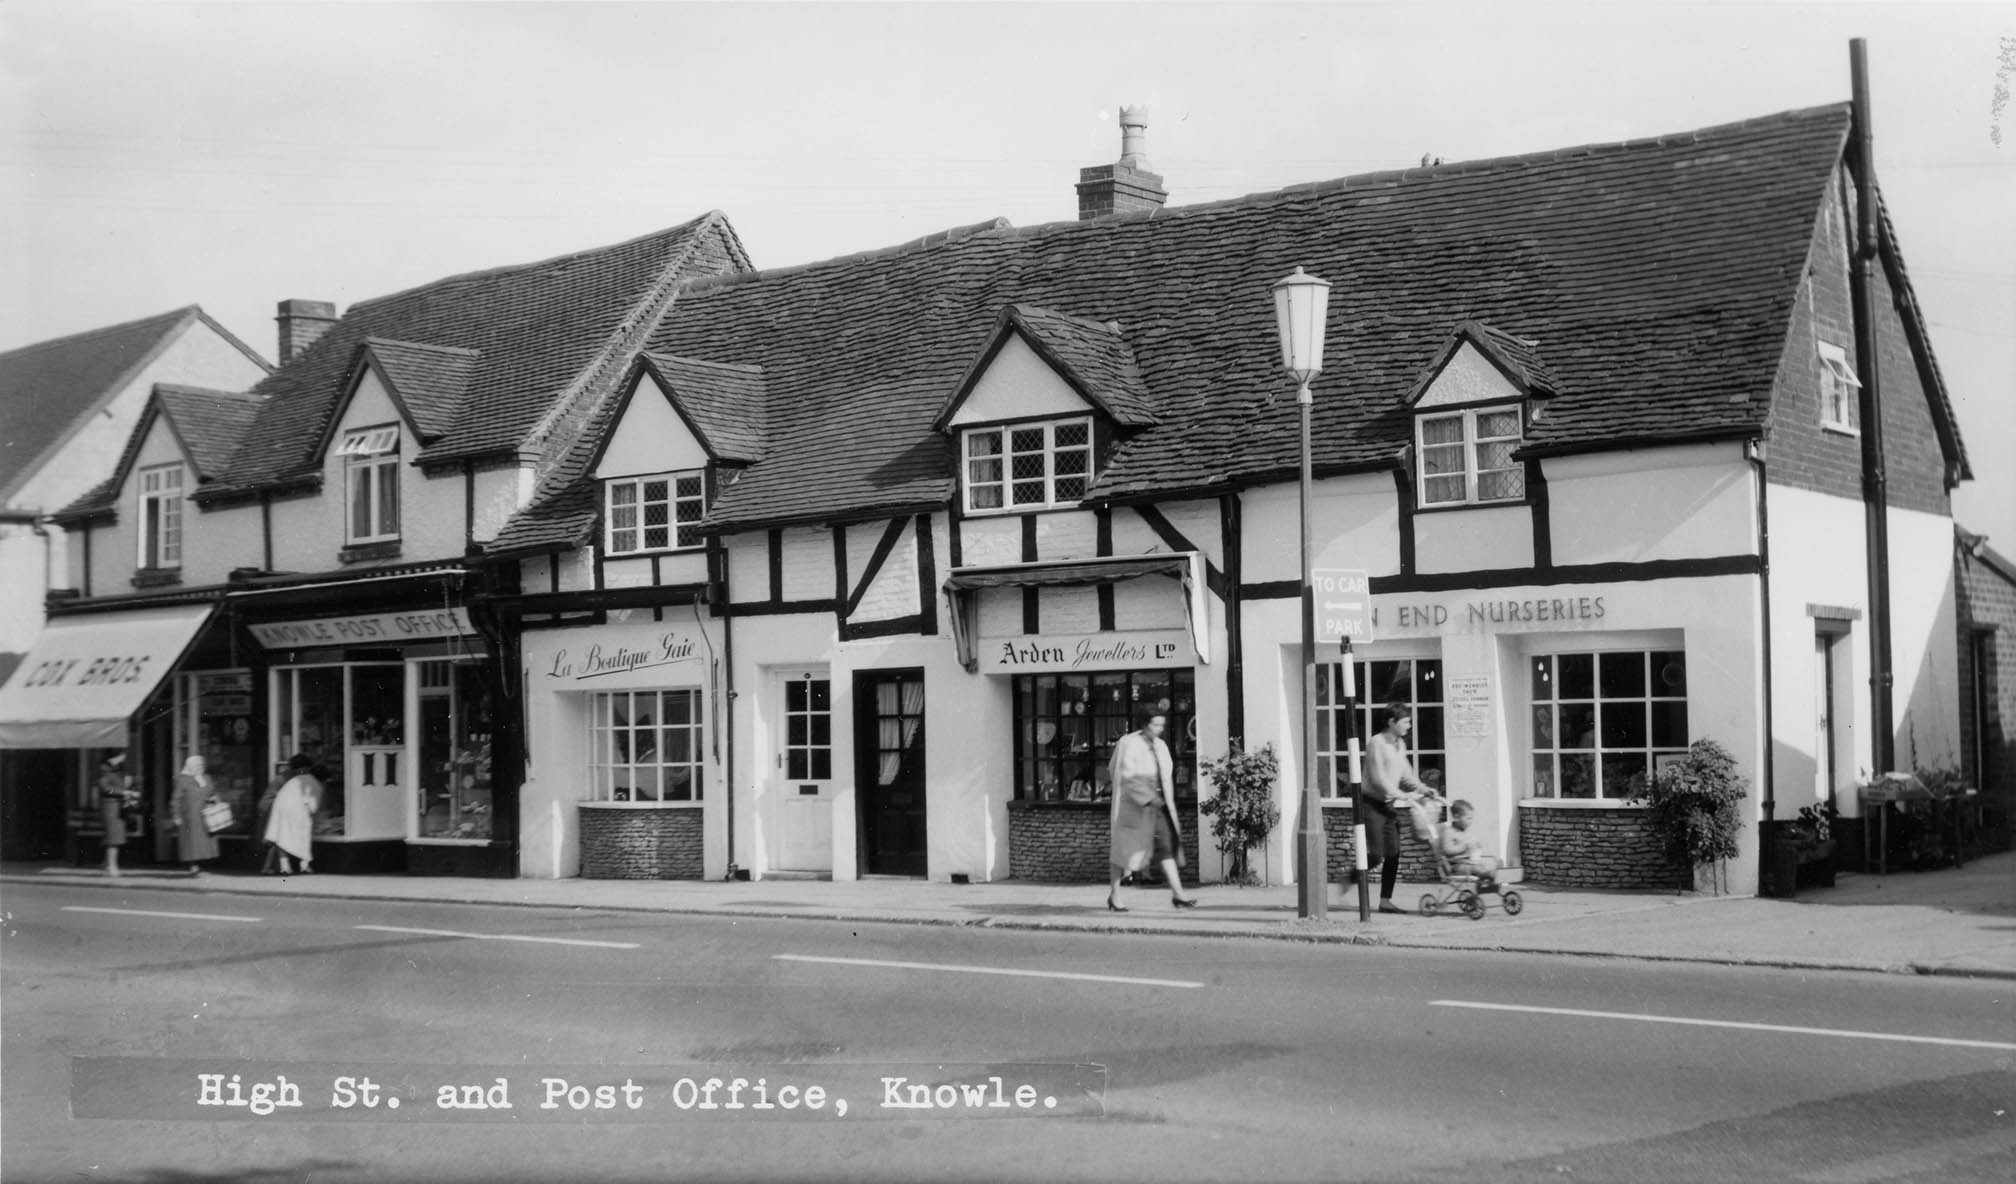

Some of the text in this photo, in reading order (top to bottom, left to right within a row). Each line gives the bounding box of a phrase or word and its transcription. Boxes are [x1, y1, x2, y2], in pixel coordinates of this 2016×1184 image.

[1315, 576, 1366, 593] TO CAR
[1399, 605, 1447, 626] END
[1467, 597, 1606, 624] NURSERIES
[259, 612, 467, 643] KNOWLE POST OFFICE
[1326, 619, 1362, 635] PARK
[546, 632, 696, 678] La Boutique Gaie
[999, 641, 1065, 664] Arden
[1071, 638, 1146, 669] Jewellers
[25, 660, 80, 689] COX
